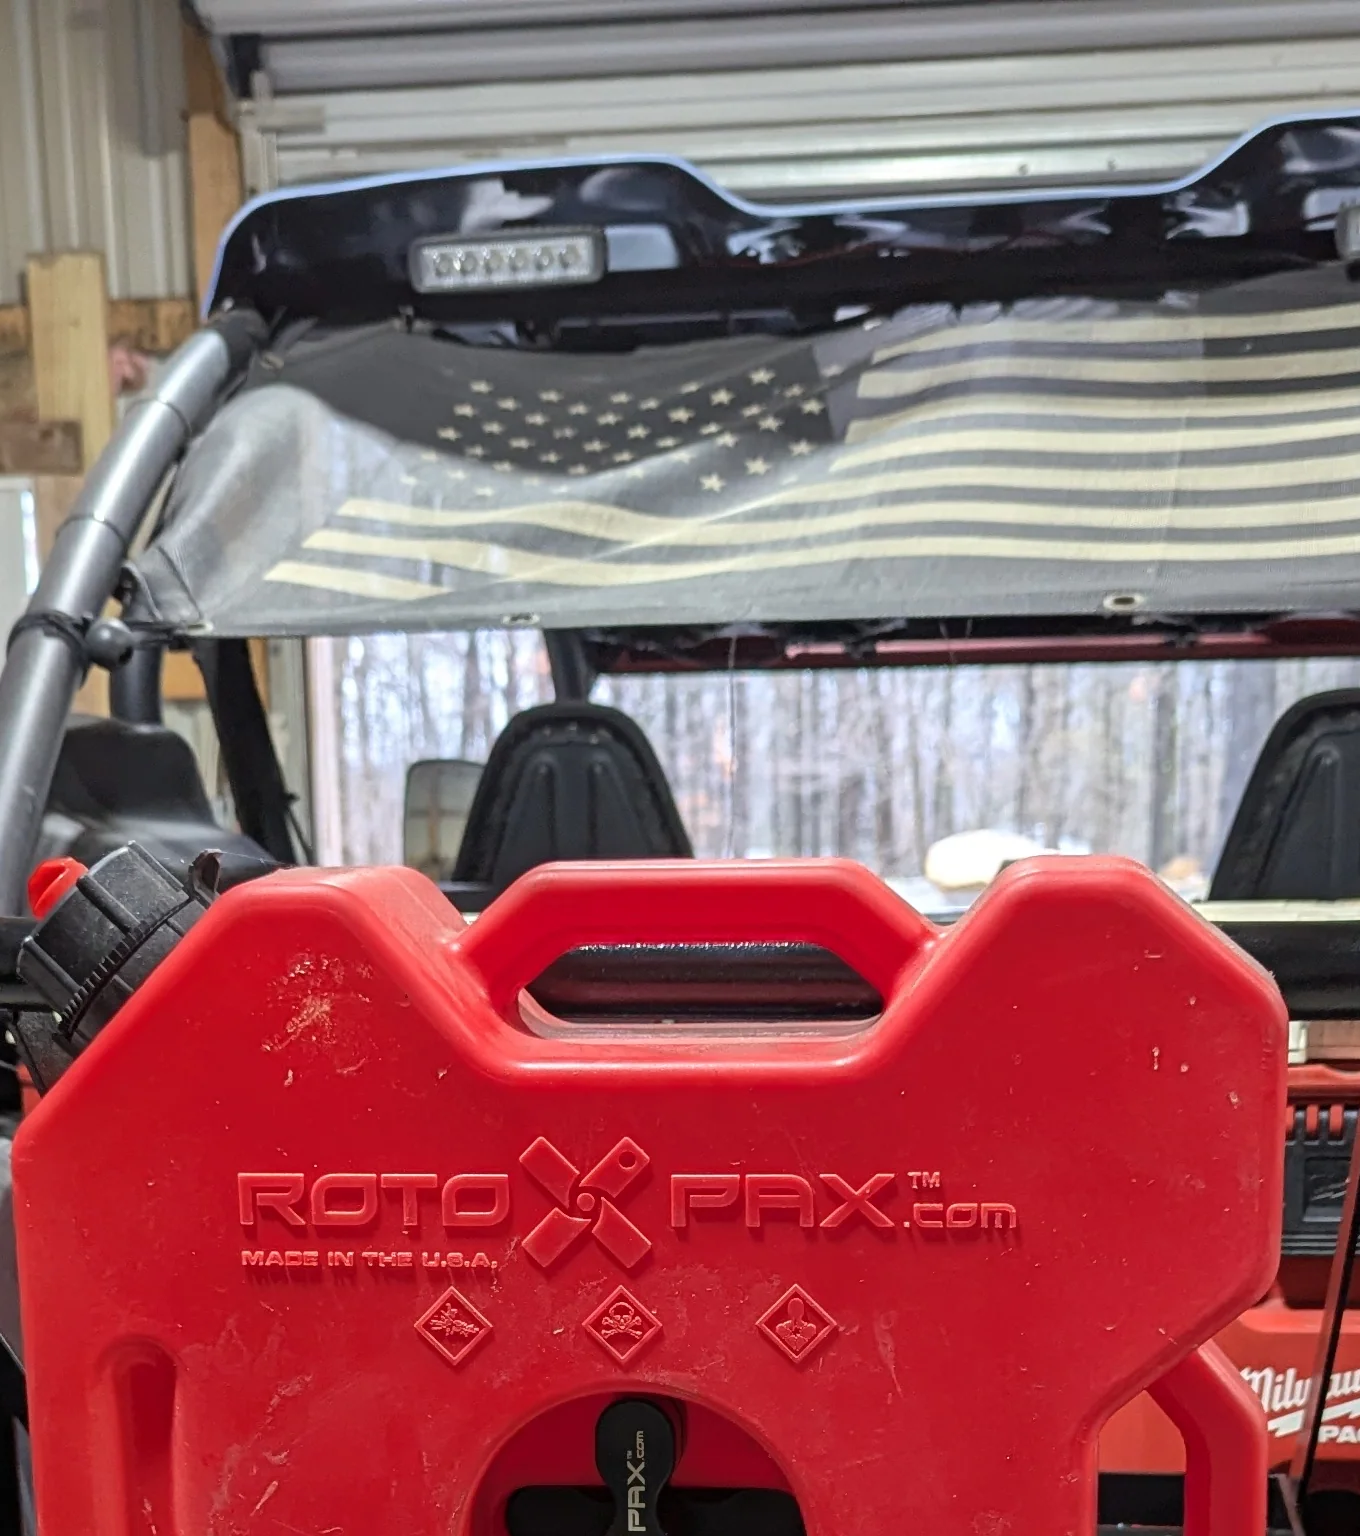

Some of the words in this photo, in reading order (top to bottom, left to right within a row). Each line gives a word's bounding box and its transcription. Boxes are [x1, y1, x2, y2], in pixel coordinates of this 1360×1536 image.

[237, 1172, 510, 1226] ROTO
[241, 1250, 319, 1267] MADE
[327, 1251, 355, 1267] IN
[362, 1251, 413, 1267] THE
